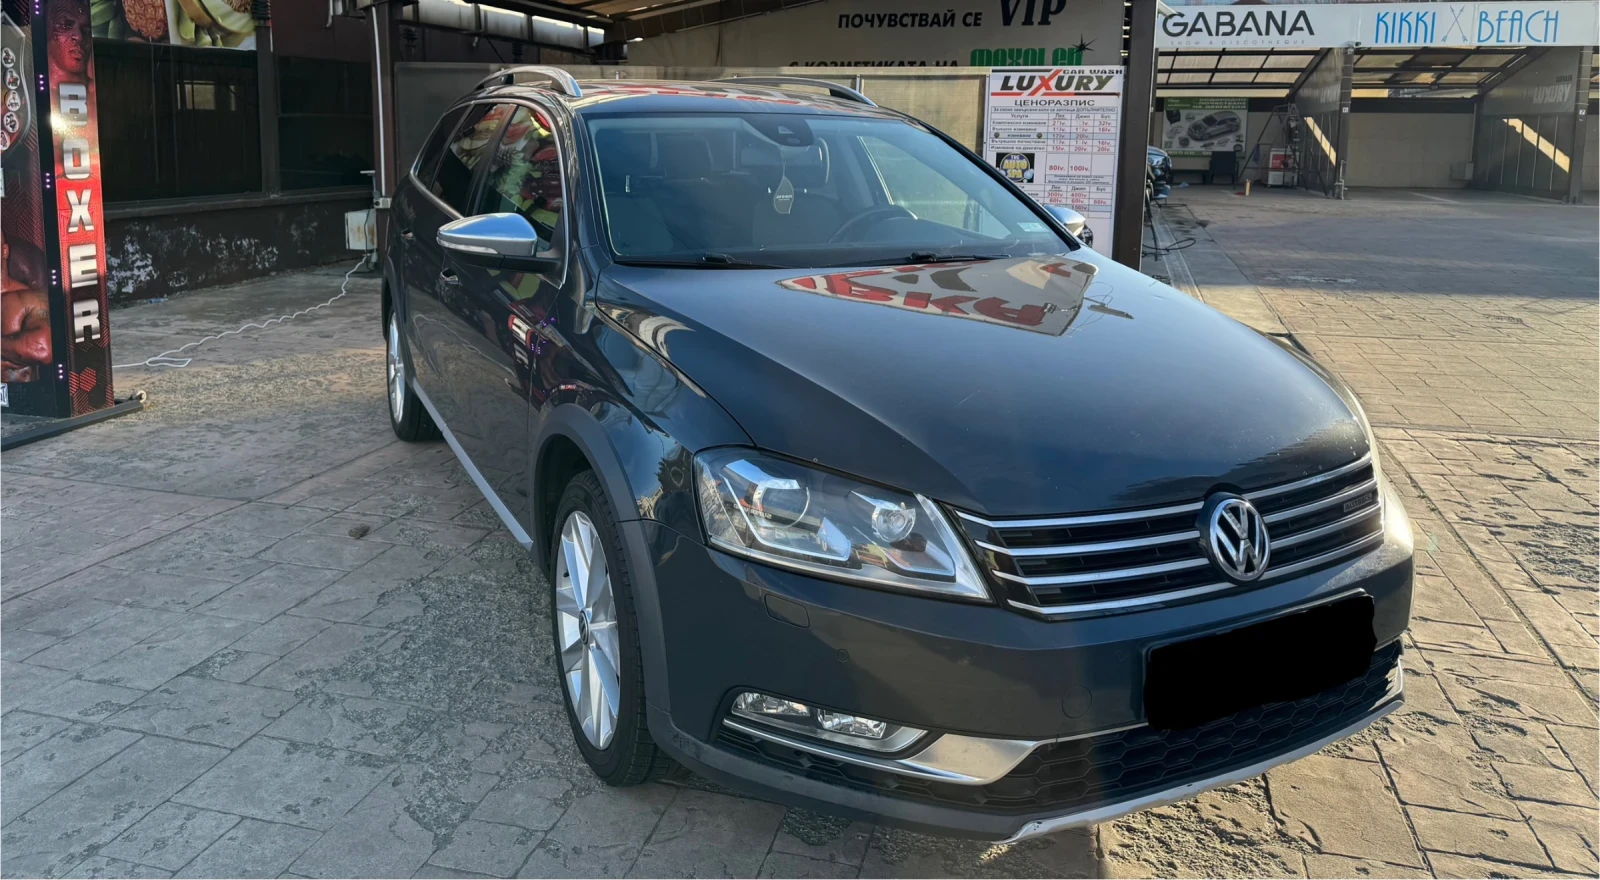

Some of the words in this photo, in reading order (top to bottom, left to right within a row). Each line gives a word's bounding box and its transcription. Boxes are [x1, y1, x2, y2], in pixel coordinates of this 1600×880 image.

[838, 10, 955, 28] ПОЧУВСТВАЙ
[962, 12, 982, 27] СЕ
[1000, 0, 1066, 26] VIP
[1162, 10, 1315, 37] GABANA
[1375, 11, 1436, 43] KIKKI
[1477, 10, 1559, 43] BEACH
[1000, 71, 1114, 95] LUXURY
[1532, 84, 1571, 104] LUXURY
[1014, 99, 1095, 107] ЦЕНОРАЗПИС
[1004, 160, 1027, 169] AUTO
[59, 83, 101, 343] BOXER
